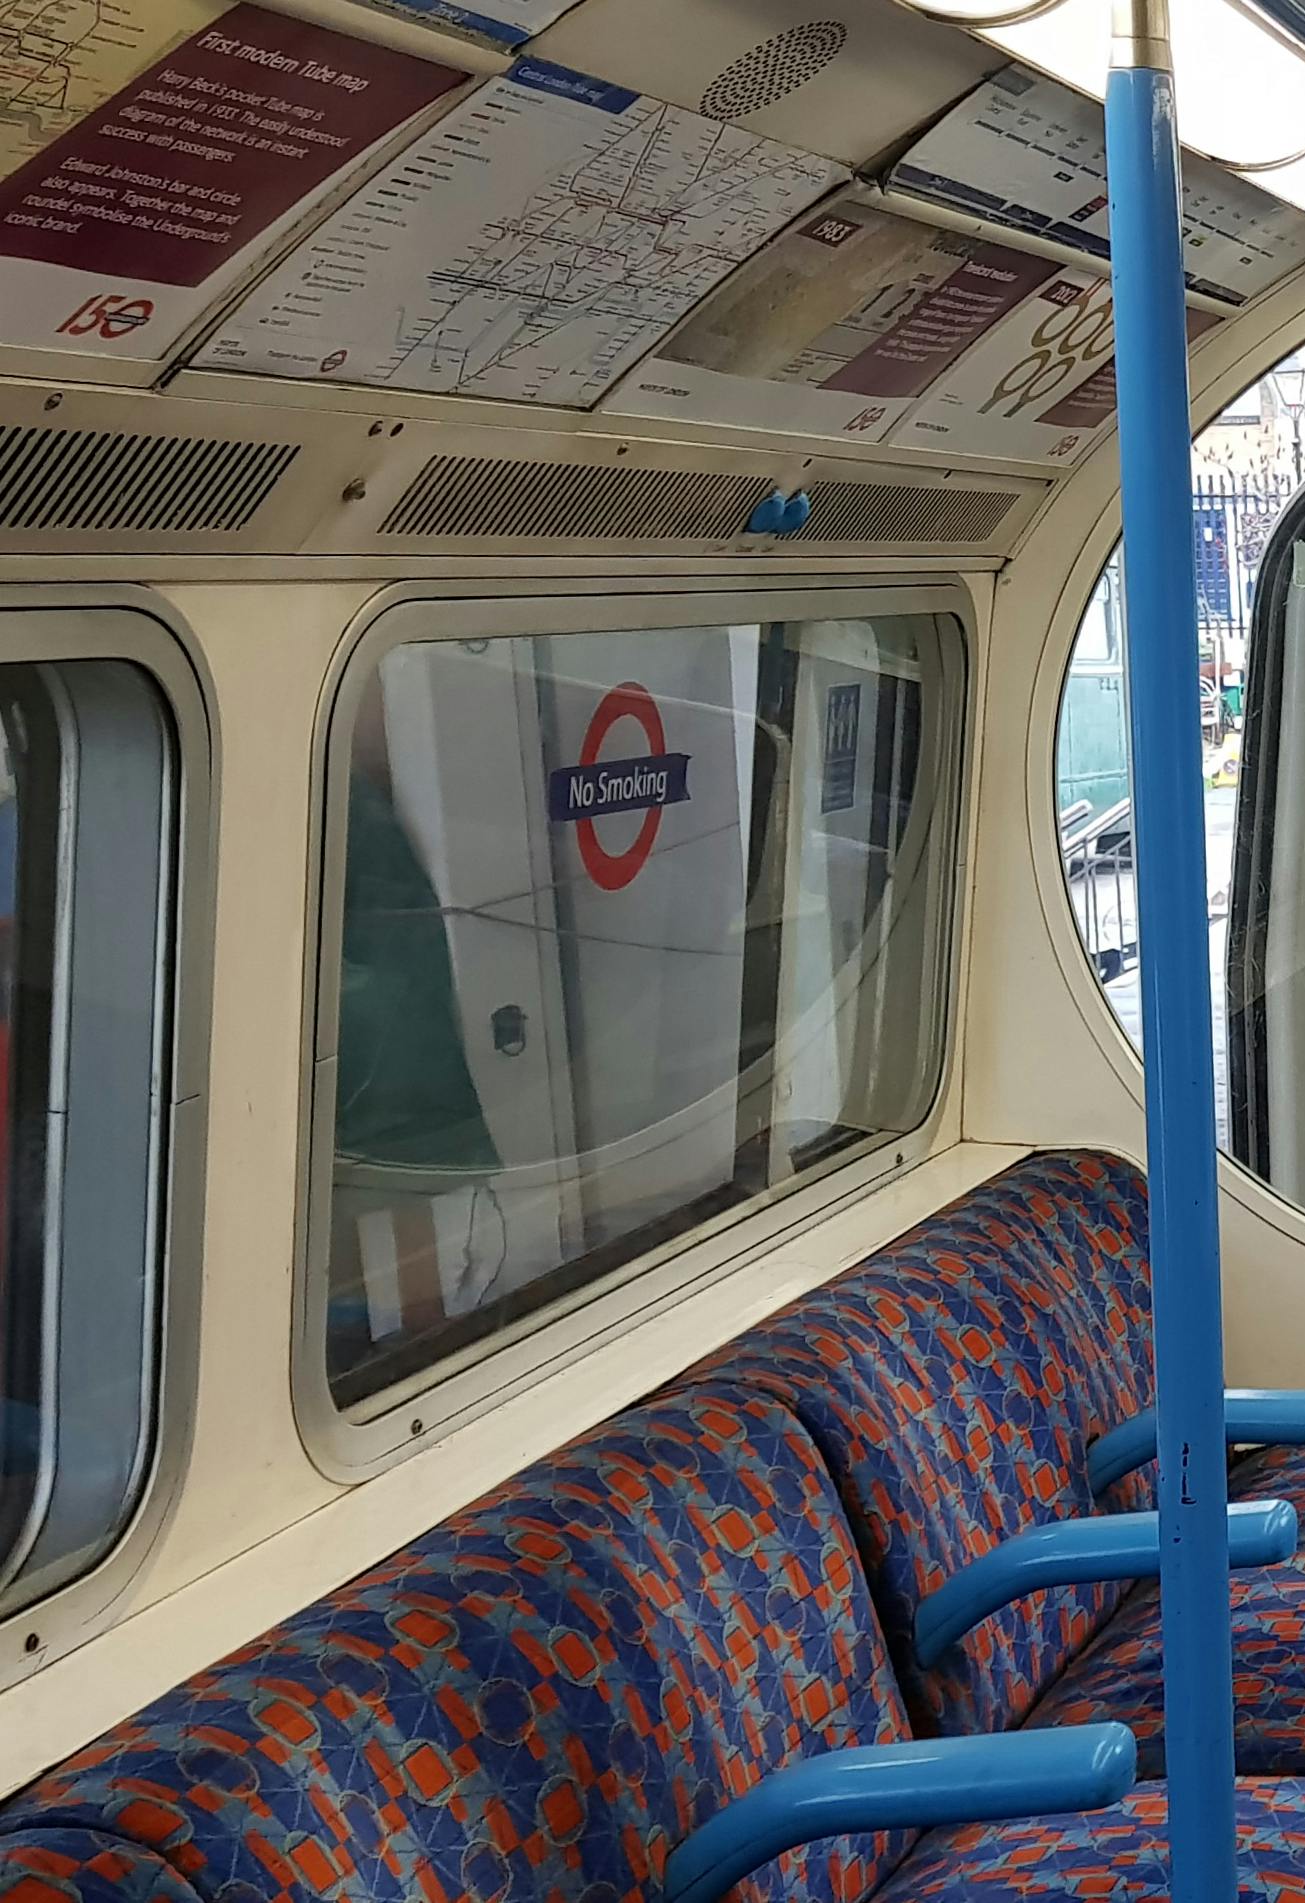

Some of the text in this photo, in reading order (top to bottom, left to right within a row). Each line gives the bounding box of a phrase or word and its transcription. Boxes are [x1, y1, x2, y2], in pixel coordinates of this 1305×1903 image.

[157, 69, 193, 89] Harry
[196, 31, 369, 93] First modern Tube map
[812, 219, 853, 242] 1983
[54, 293, 155, 339] 150
[568, 766, 669, 808] No Smoking
